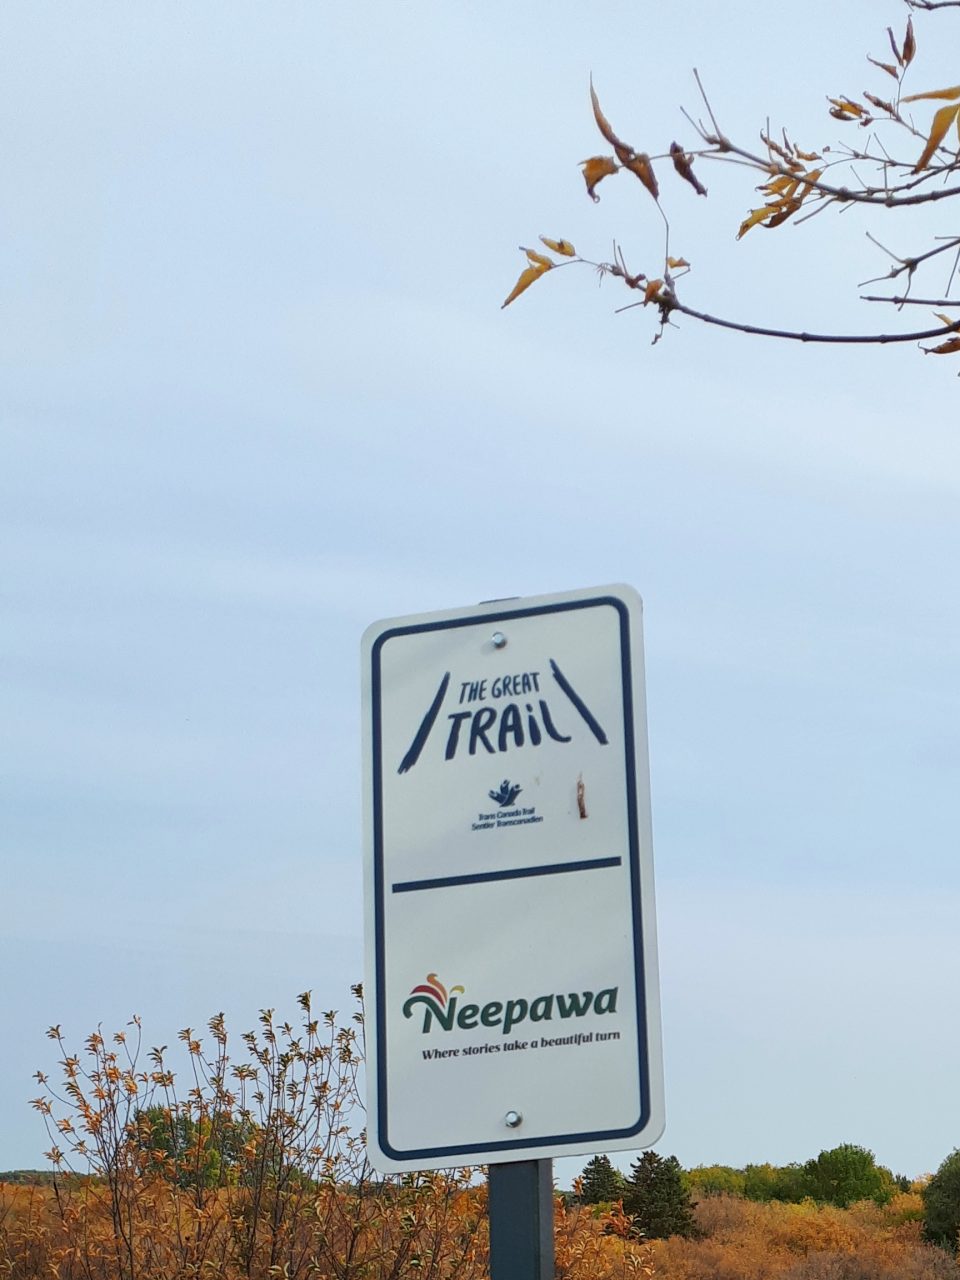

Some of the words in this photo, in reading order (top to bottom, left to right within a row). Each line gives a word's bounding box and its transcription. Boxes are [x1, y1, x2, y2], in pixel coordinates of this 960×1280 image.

[459, 679, 487, 704] THE
[491, 672, 540, 699] GREAT
[471, 822, 495, 831] Sentier
[478, 813, 496, 822] Trans
[497, 809, 522, 819] Canada
[522, 807, 536, 816] Trail
[403, 987, 619, 1035] Neepawa
[422, 1048, 460, 1061] Where
[462, 1043, 501, 1056] stories
[503, 1040, 529, 1052] take
[530, 1040, 538, 1049] a
[540, 1031, 593, 1048] beautiful
[595, 1031, 621, 1042] turn
